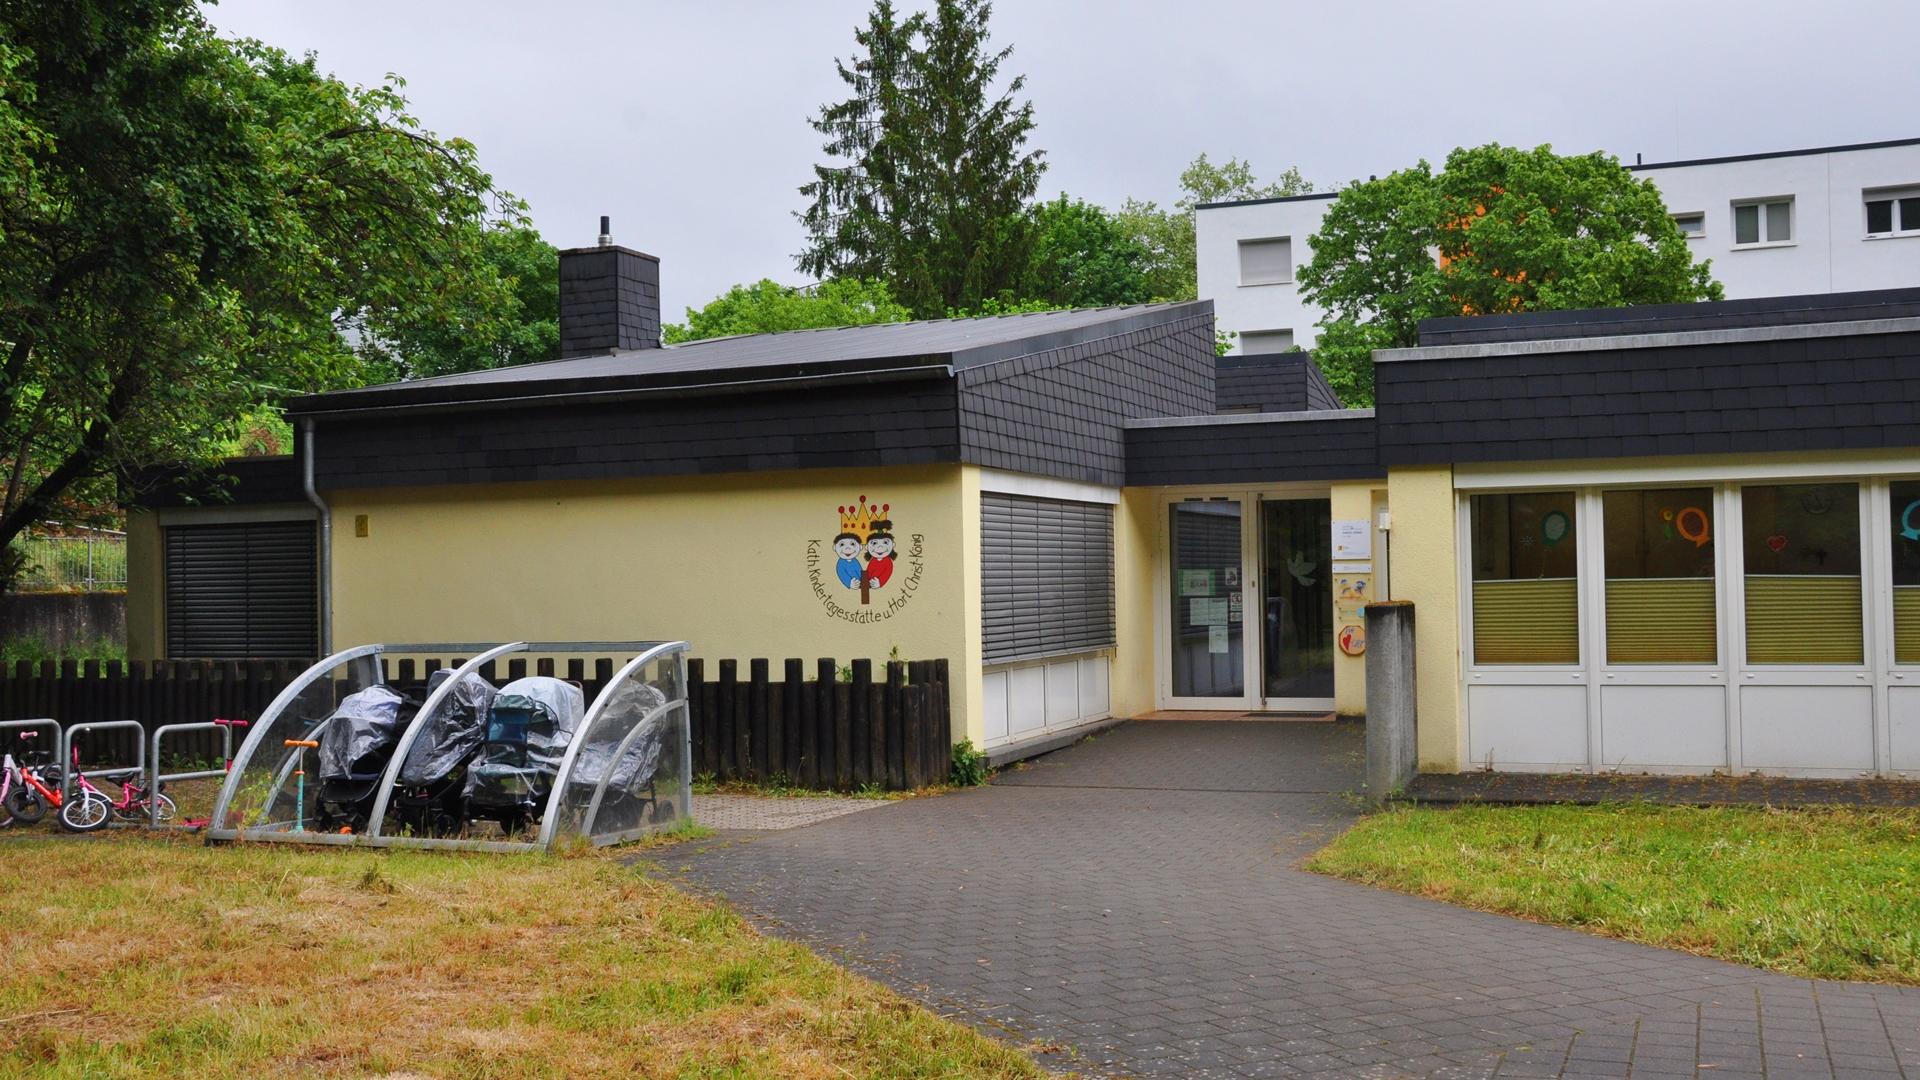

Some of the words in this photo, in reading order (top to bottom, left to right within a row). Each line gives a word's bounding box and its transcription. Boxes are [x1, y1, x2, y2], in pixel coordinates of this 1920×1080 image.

[809, 568, 882, 624] Kindertagesstätte
[888, 588, 912, 615] Hort
[904, 534, 925, 591] Christ-König
